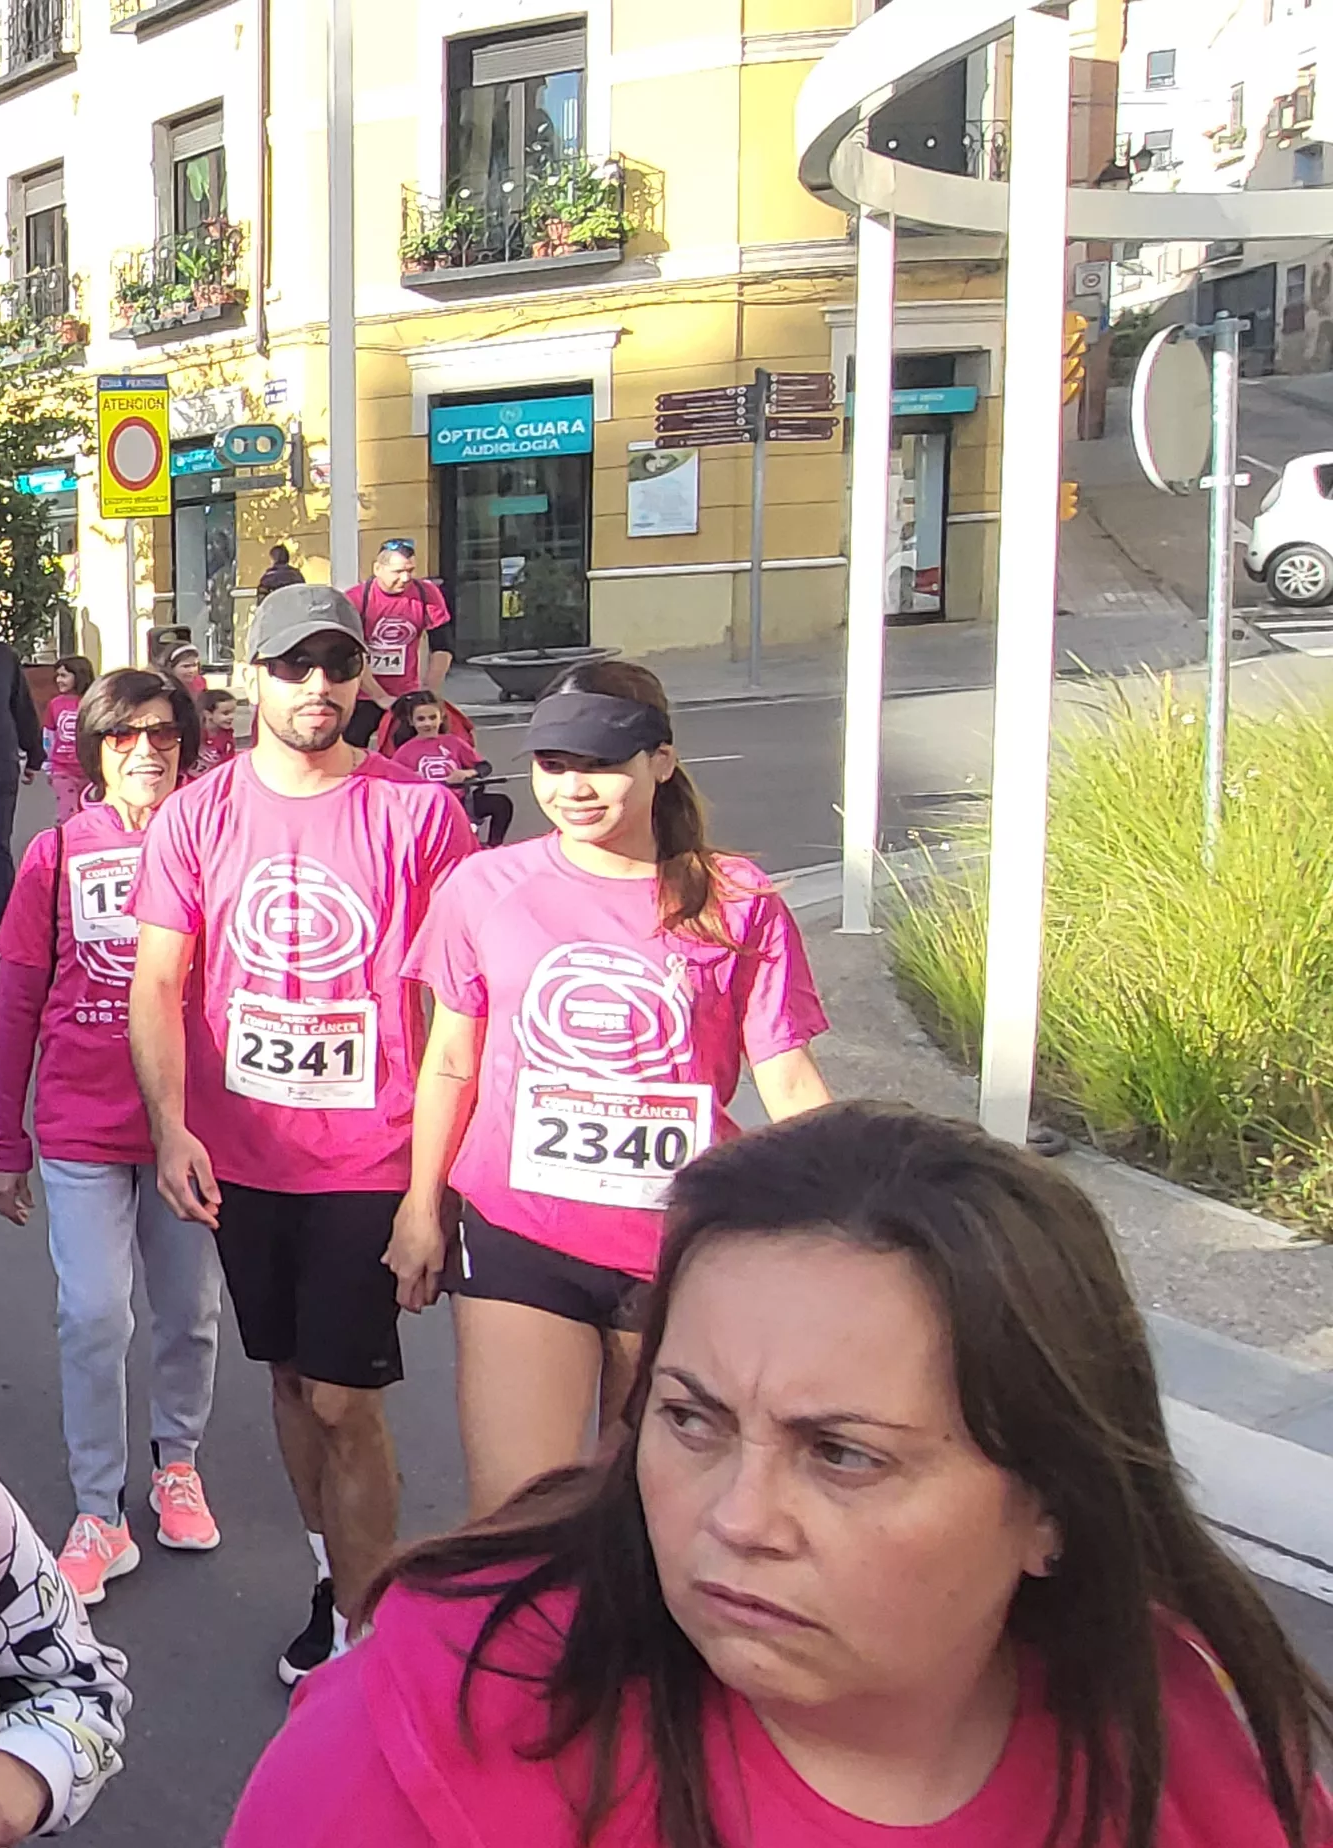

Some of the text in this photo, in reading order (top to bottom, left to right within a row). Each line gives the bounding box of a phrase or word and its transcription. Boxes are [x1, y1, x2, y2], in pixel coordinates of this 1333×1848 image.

[437, 419, 585, 444] ÓPTICA GUARA
[462, 437, 560, 457] AUDIOLOGÍA
[241, 1032, 355, 1077] 2341
[629, 1104, 690, 1120] CÁNCER
[534, 1117, 688, 1170] 2340
